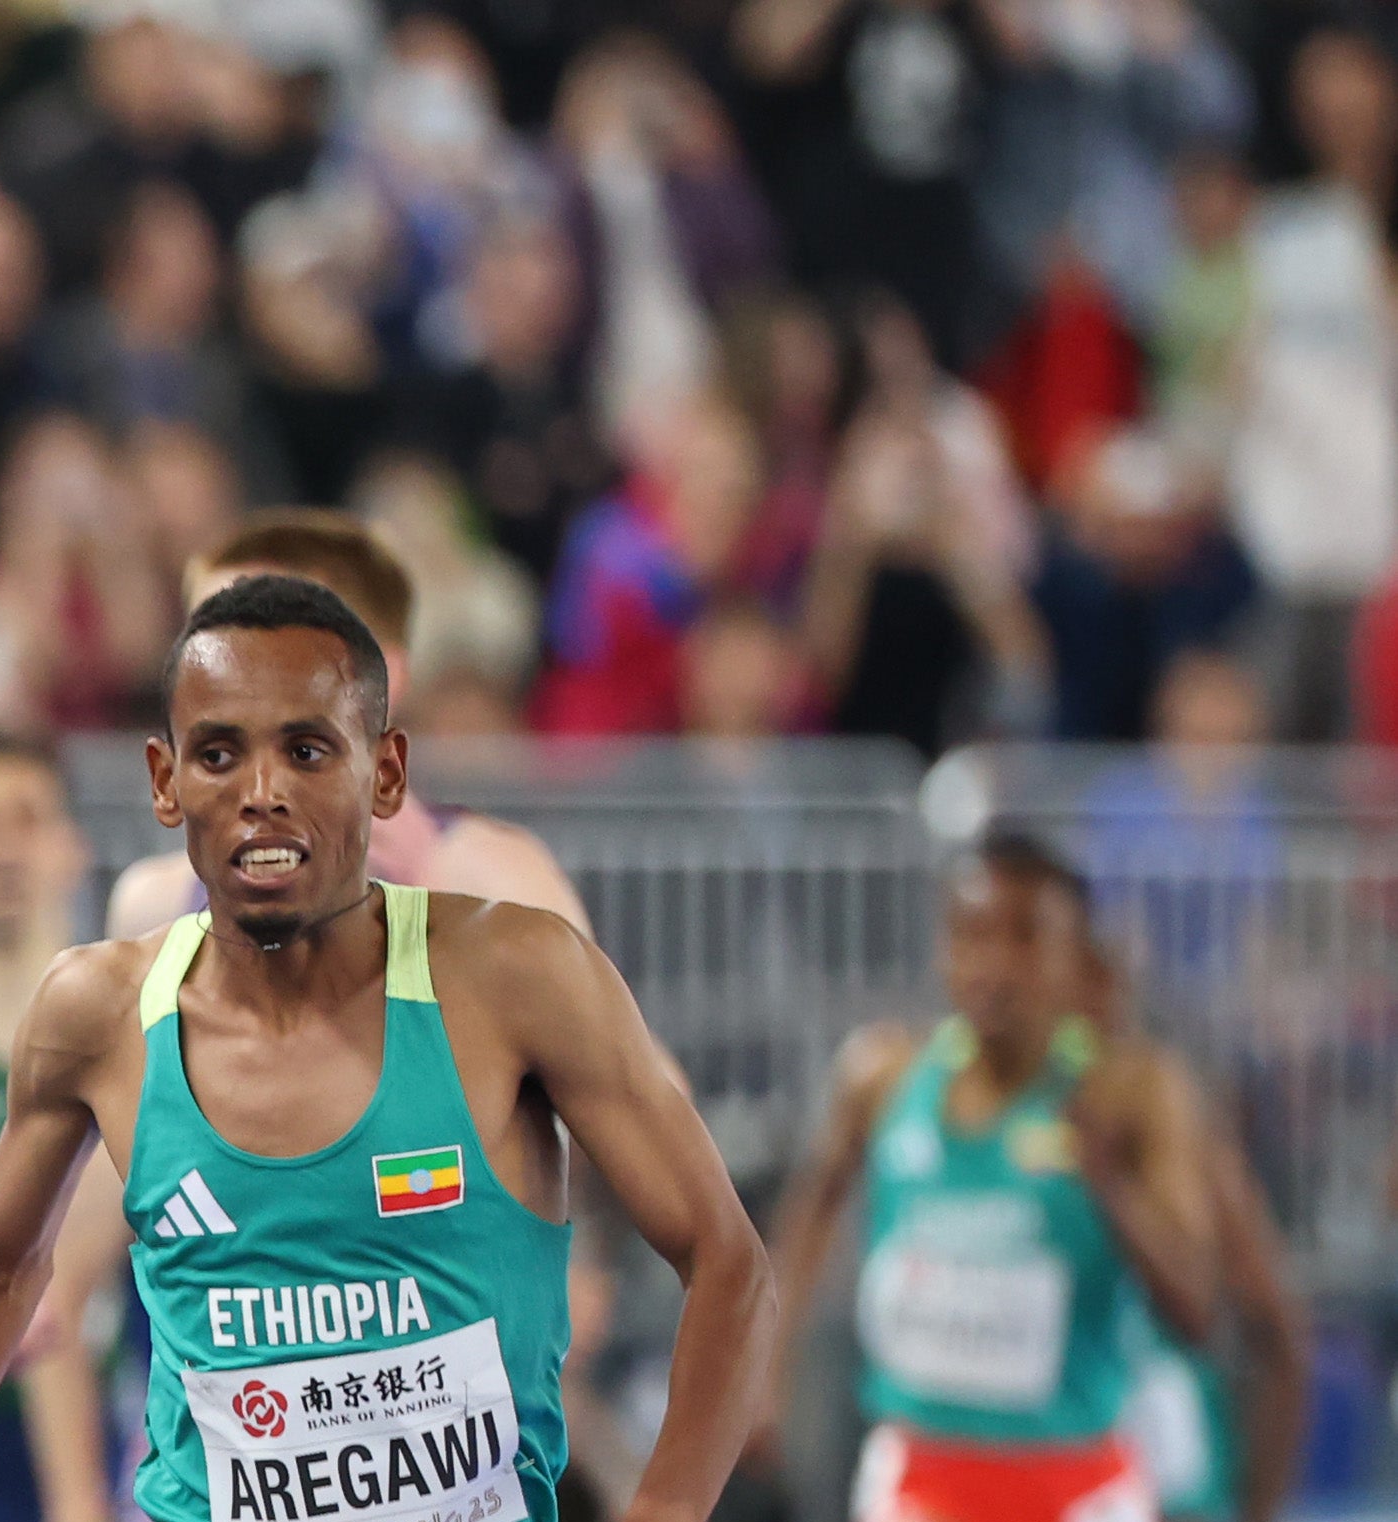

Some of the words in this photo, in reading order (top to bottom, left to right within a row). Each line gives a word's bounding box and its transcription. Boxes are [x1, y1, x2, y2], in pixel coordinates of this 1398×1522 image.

[207, 1276, 431, 1348] ETHIOPIA
[301, 1354, 446, 1414] 南京银行
[307, 1412, 353, 1431] BANK
[358, 1409, 378, 1423] OF
[384, 1393, 453, 1420] NANJING
[230, 1410, 502, 1521] AREGAWI
